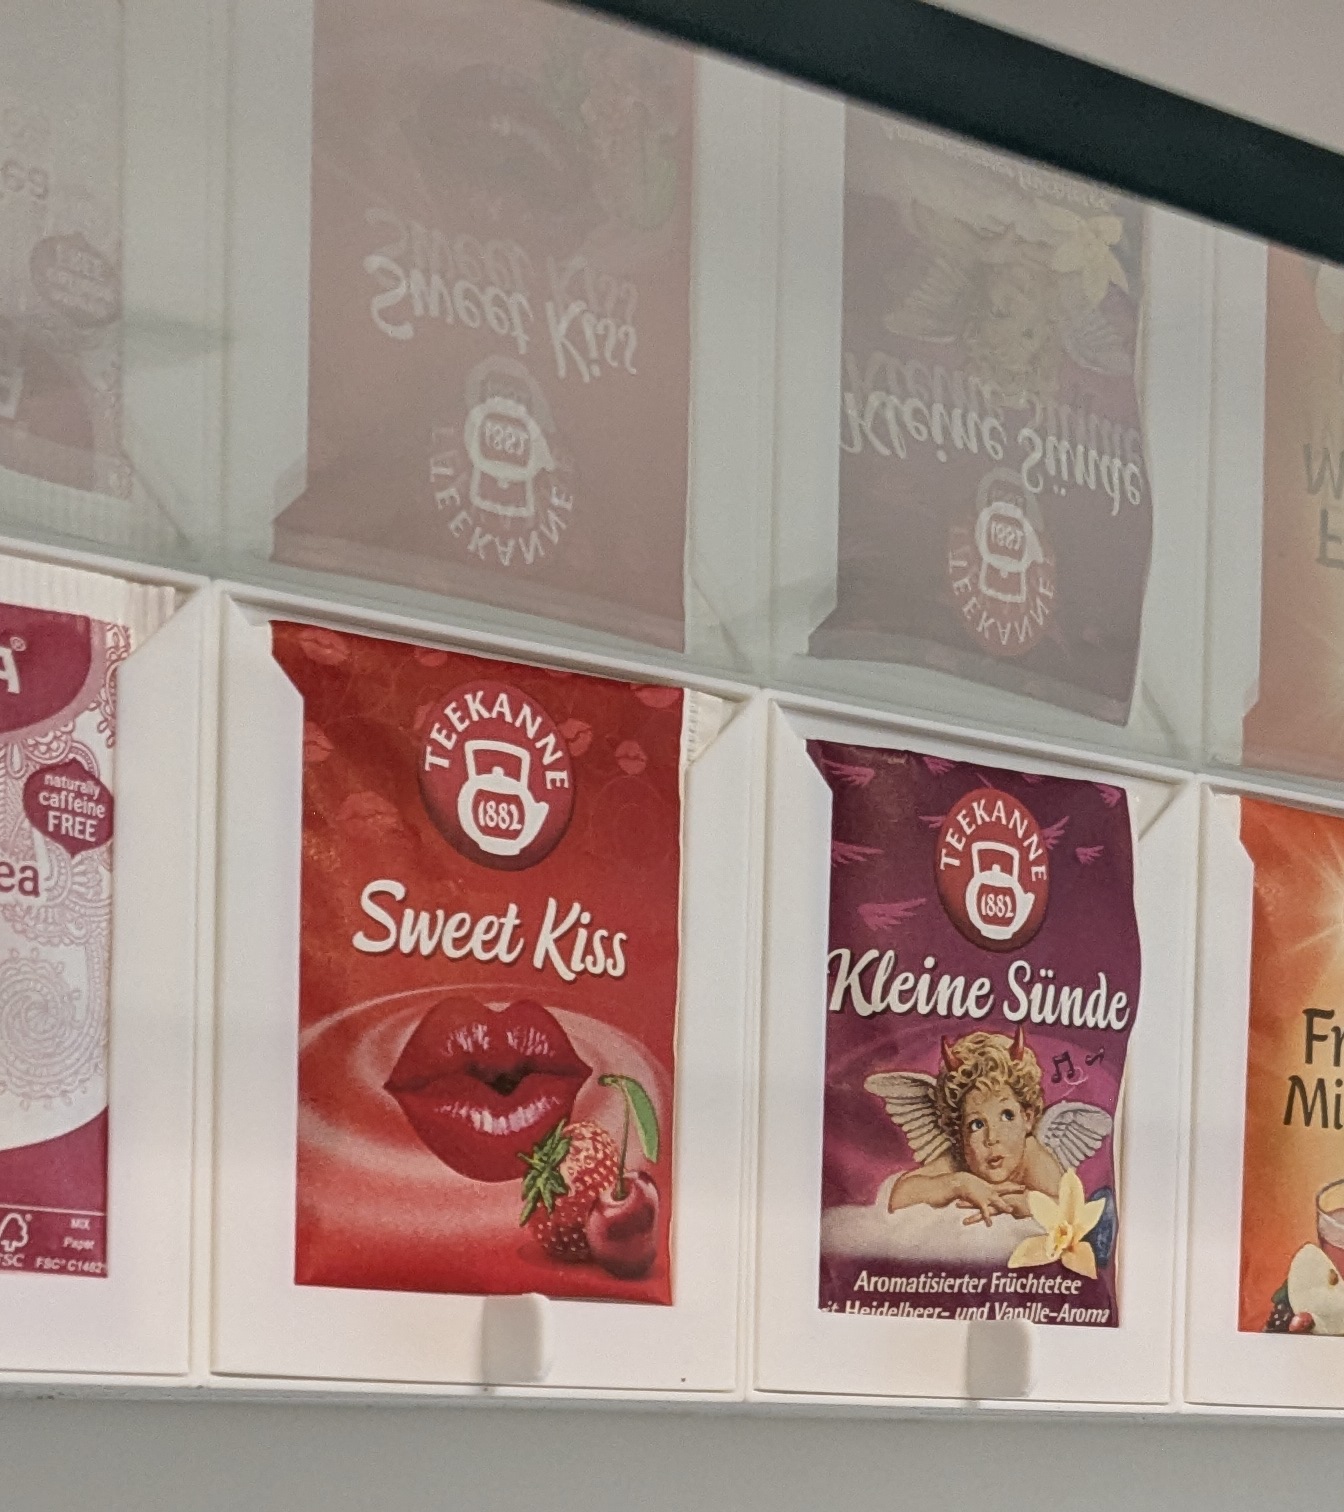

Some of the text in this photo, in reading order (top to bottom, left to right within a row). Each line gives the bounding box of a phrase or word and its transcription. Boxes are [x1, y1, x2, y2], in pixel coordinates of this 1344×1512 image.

[424, 690, 570, 790] TEEKANNE
[38, 791, 107, 819] caffeine
[478, 800, 523, 831] 1882
[47, 811, 98, 843] FREE
[939, 799, 1047, 883] TEEKANNE
[980, 893, 1015, 919] 1882
[351, 878, 629, 982] Sweet Kiss
[827, 947, 1131, 1031] Kleine Sünde
[853, 1270, 1082, 1296] Aromatisierter Früchtetee
[955, 1302, 989, 1322] und
